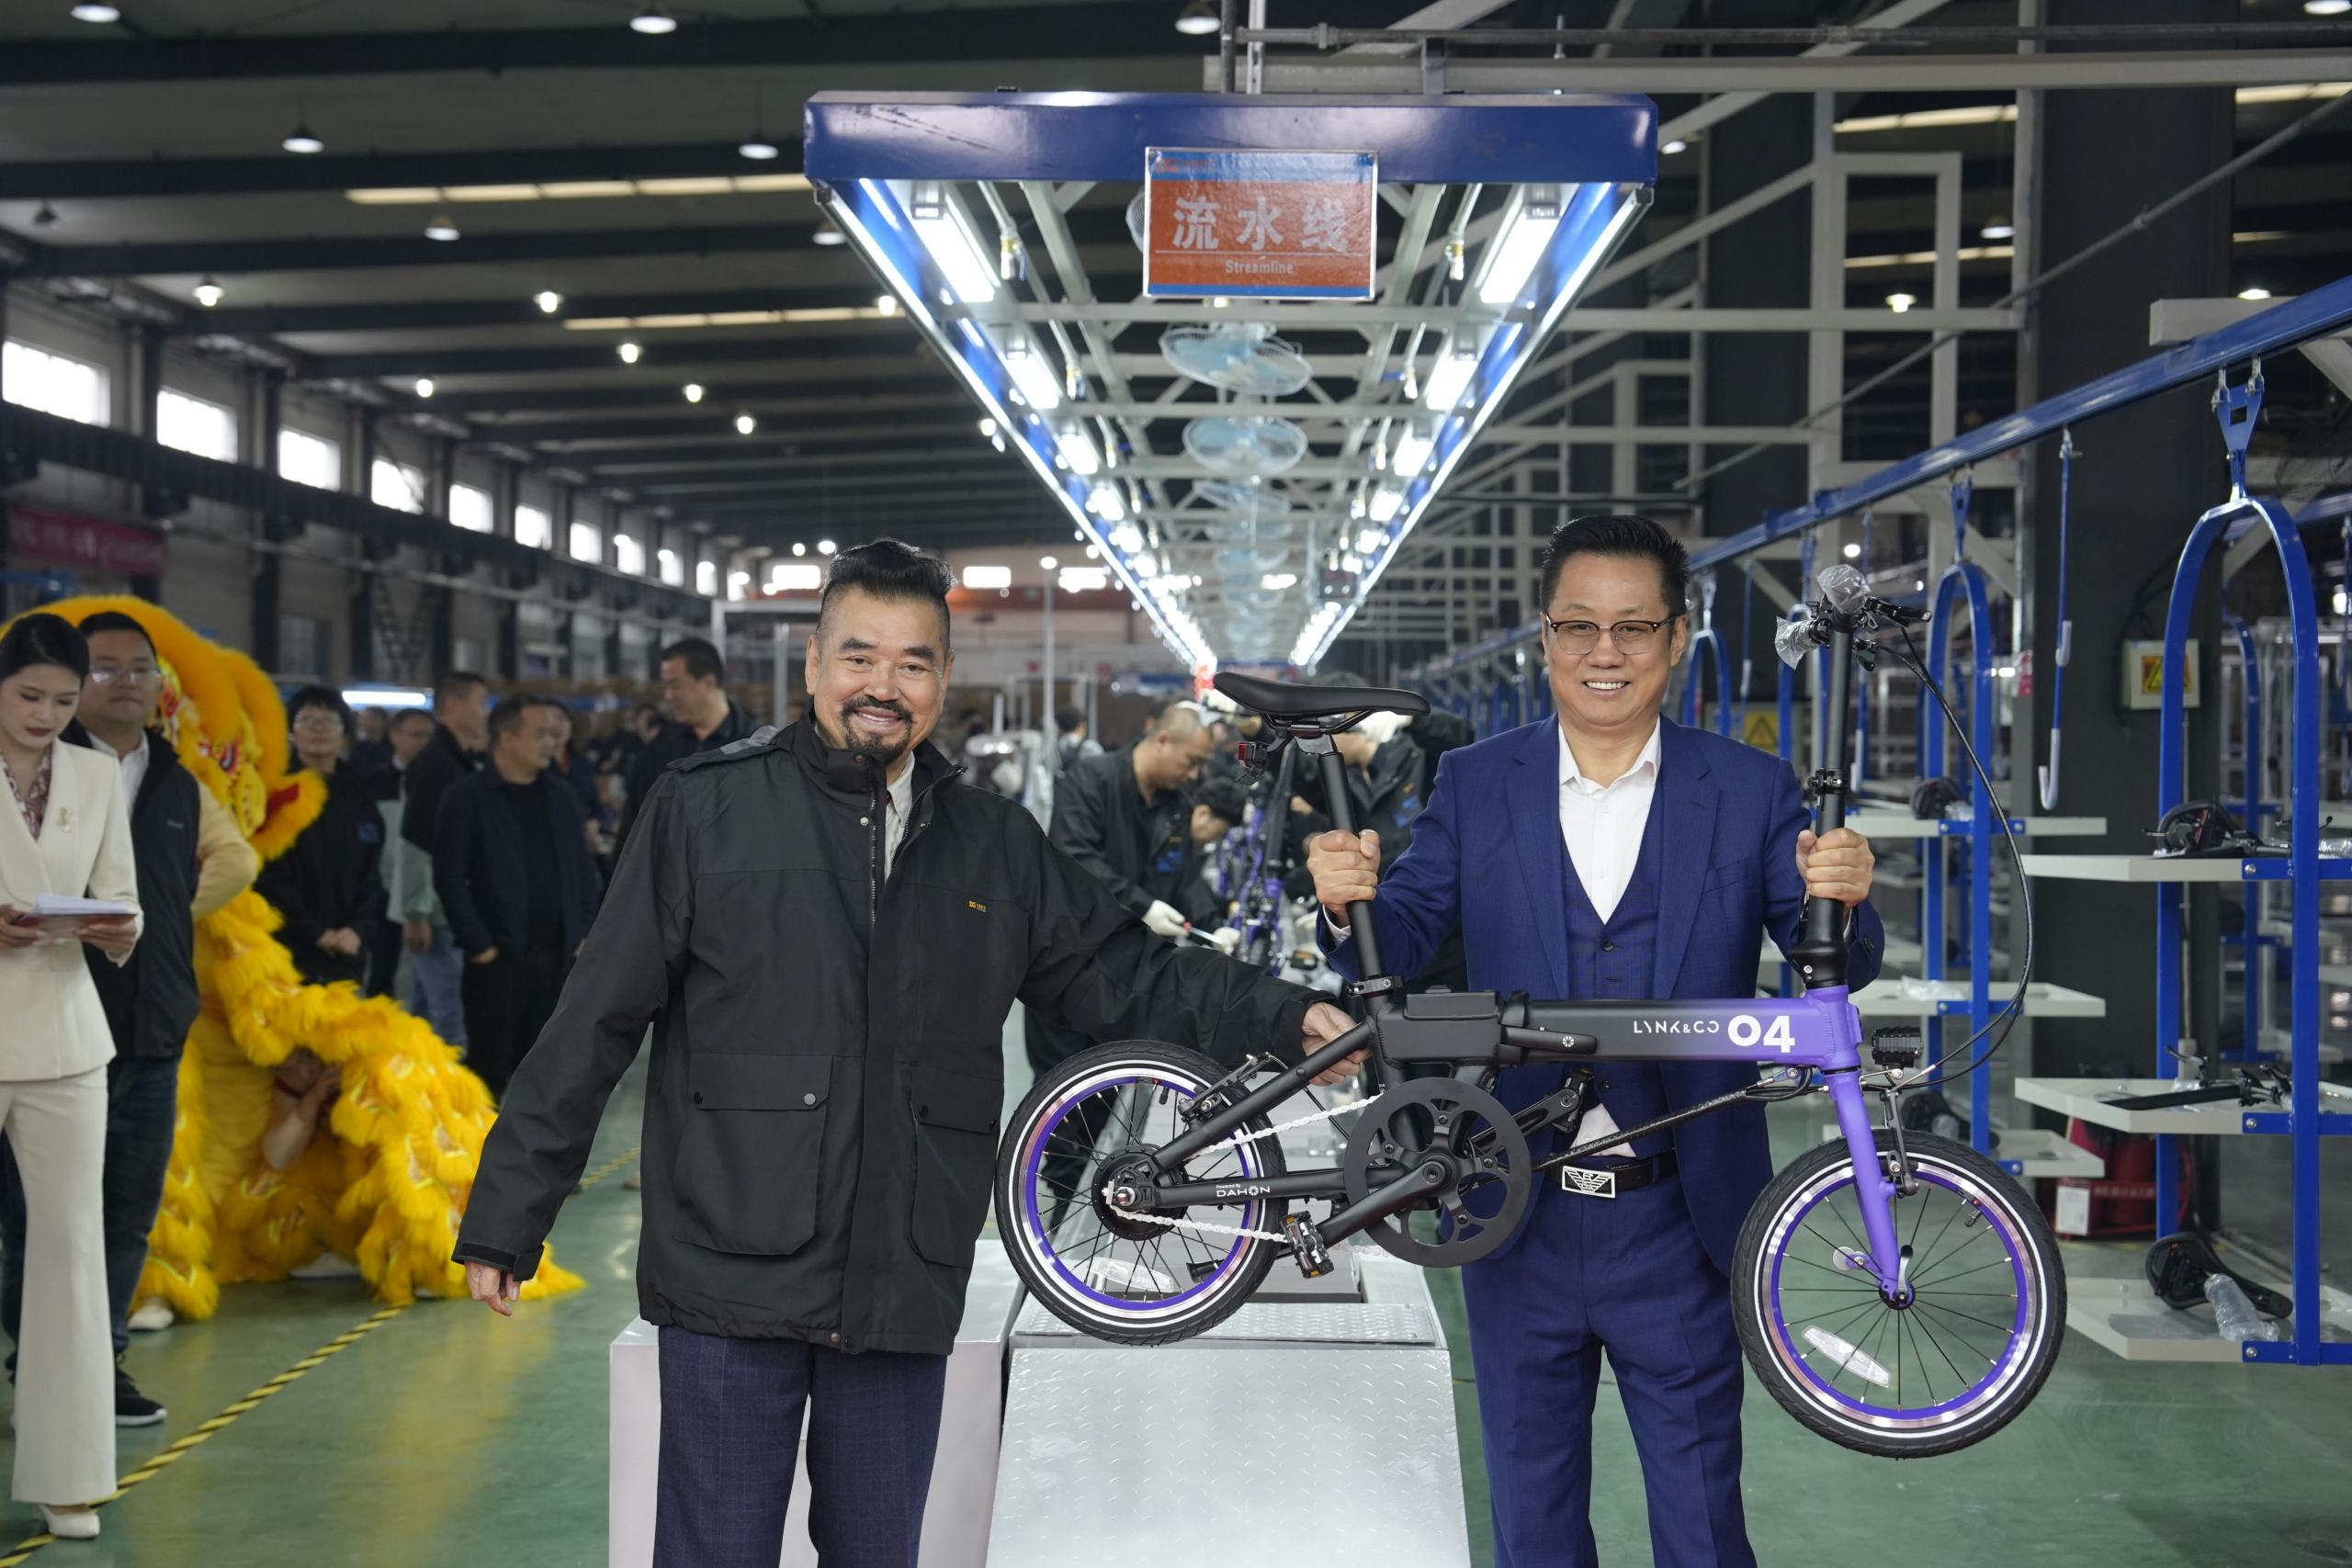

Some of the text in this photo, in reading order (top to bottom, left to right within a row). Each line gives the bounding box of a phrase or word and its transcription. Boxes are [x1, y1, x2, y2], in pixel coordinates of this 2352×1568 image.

[1172, 196, 1349, 251] 流水线
[1225, 259, 1294, 274] Streamline
[1633, 1014, 1796, 1054] LYNK&CO 04
[1216, 1185, 1271, 1198] DAHON
